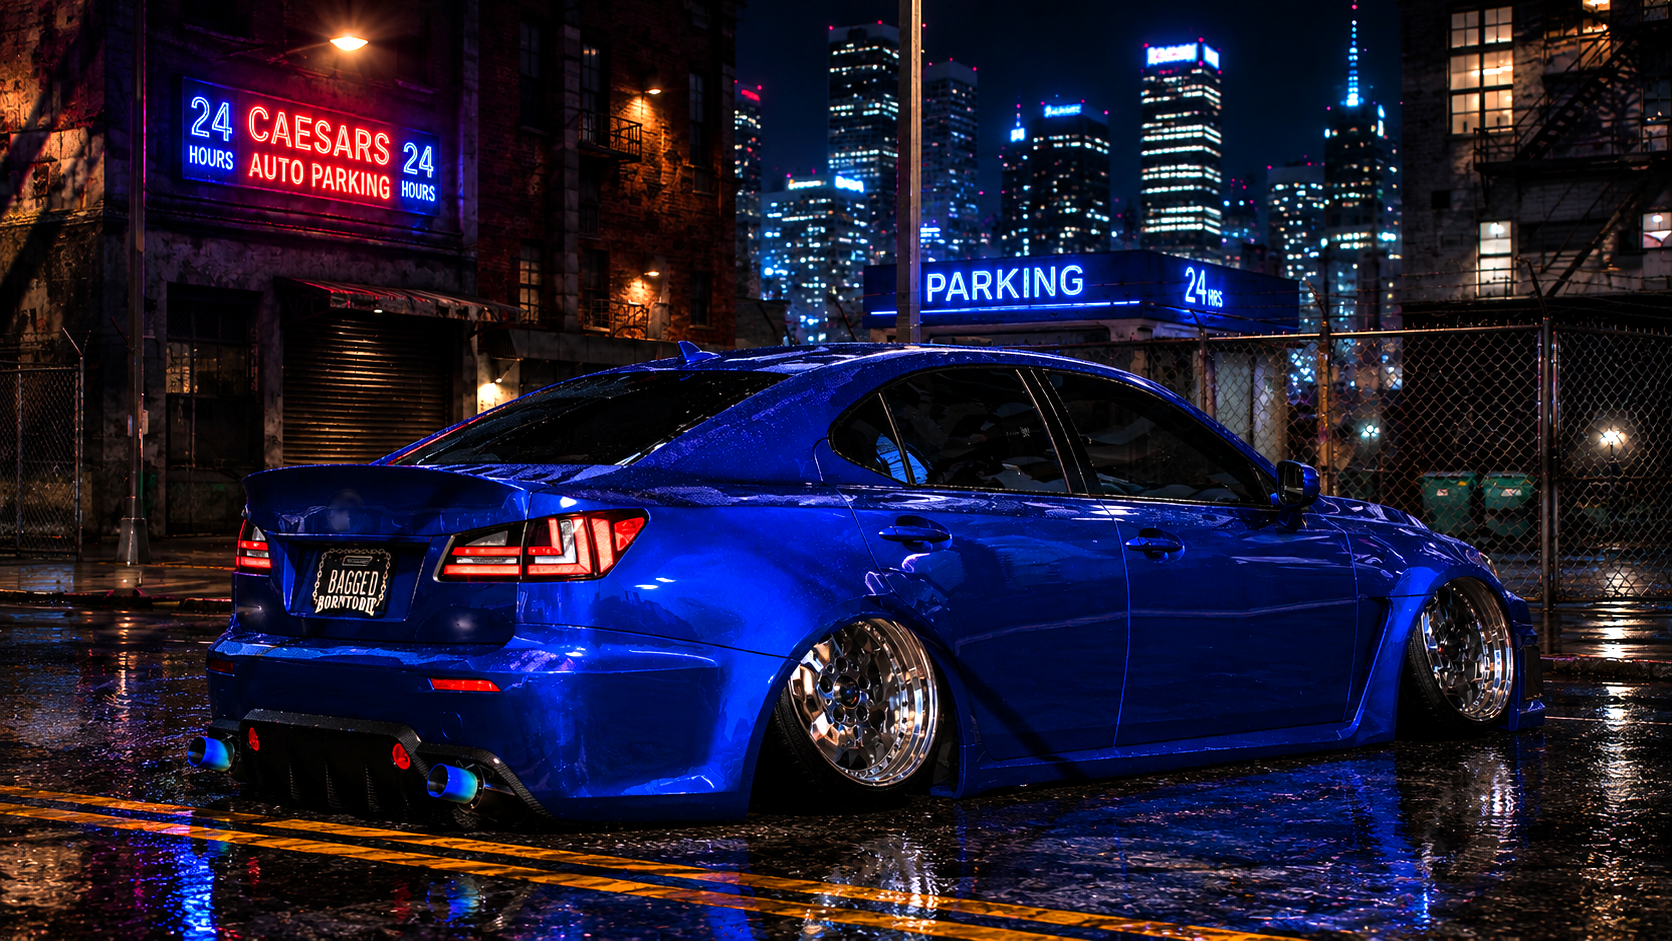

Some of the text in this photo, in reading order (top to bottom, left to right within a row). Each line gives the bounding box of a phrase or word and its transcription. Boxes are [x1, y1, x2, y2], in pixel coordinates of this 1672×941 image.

[190, 95, 233, 142] 24
[248, 106, 390, 166] CAESARS
[189, 145, 234, 170] HOURS
[403, 142, 435, 179] 24
[248, 153, 391, 200] AUTO PARKING
[401, 180, 436, 202] HOURS
[926, 265, 1084, 302] PARKING
[1184, 266, 1223, 308] 24 HRS
[327, 569, 379, 596] BAGGED
